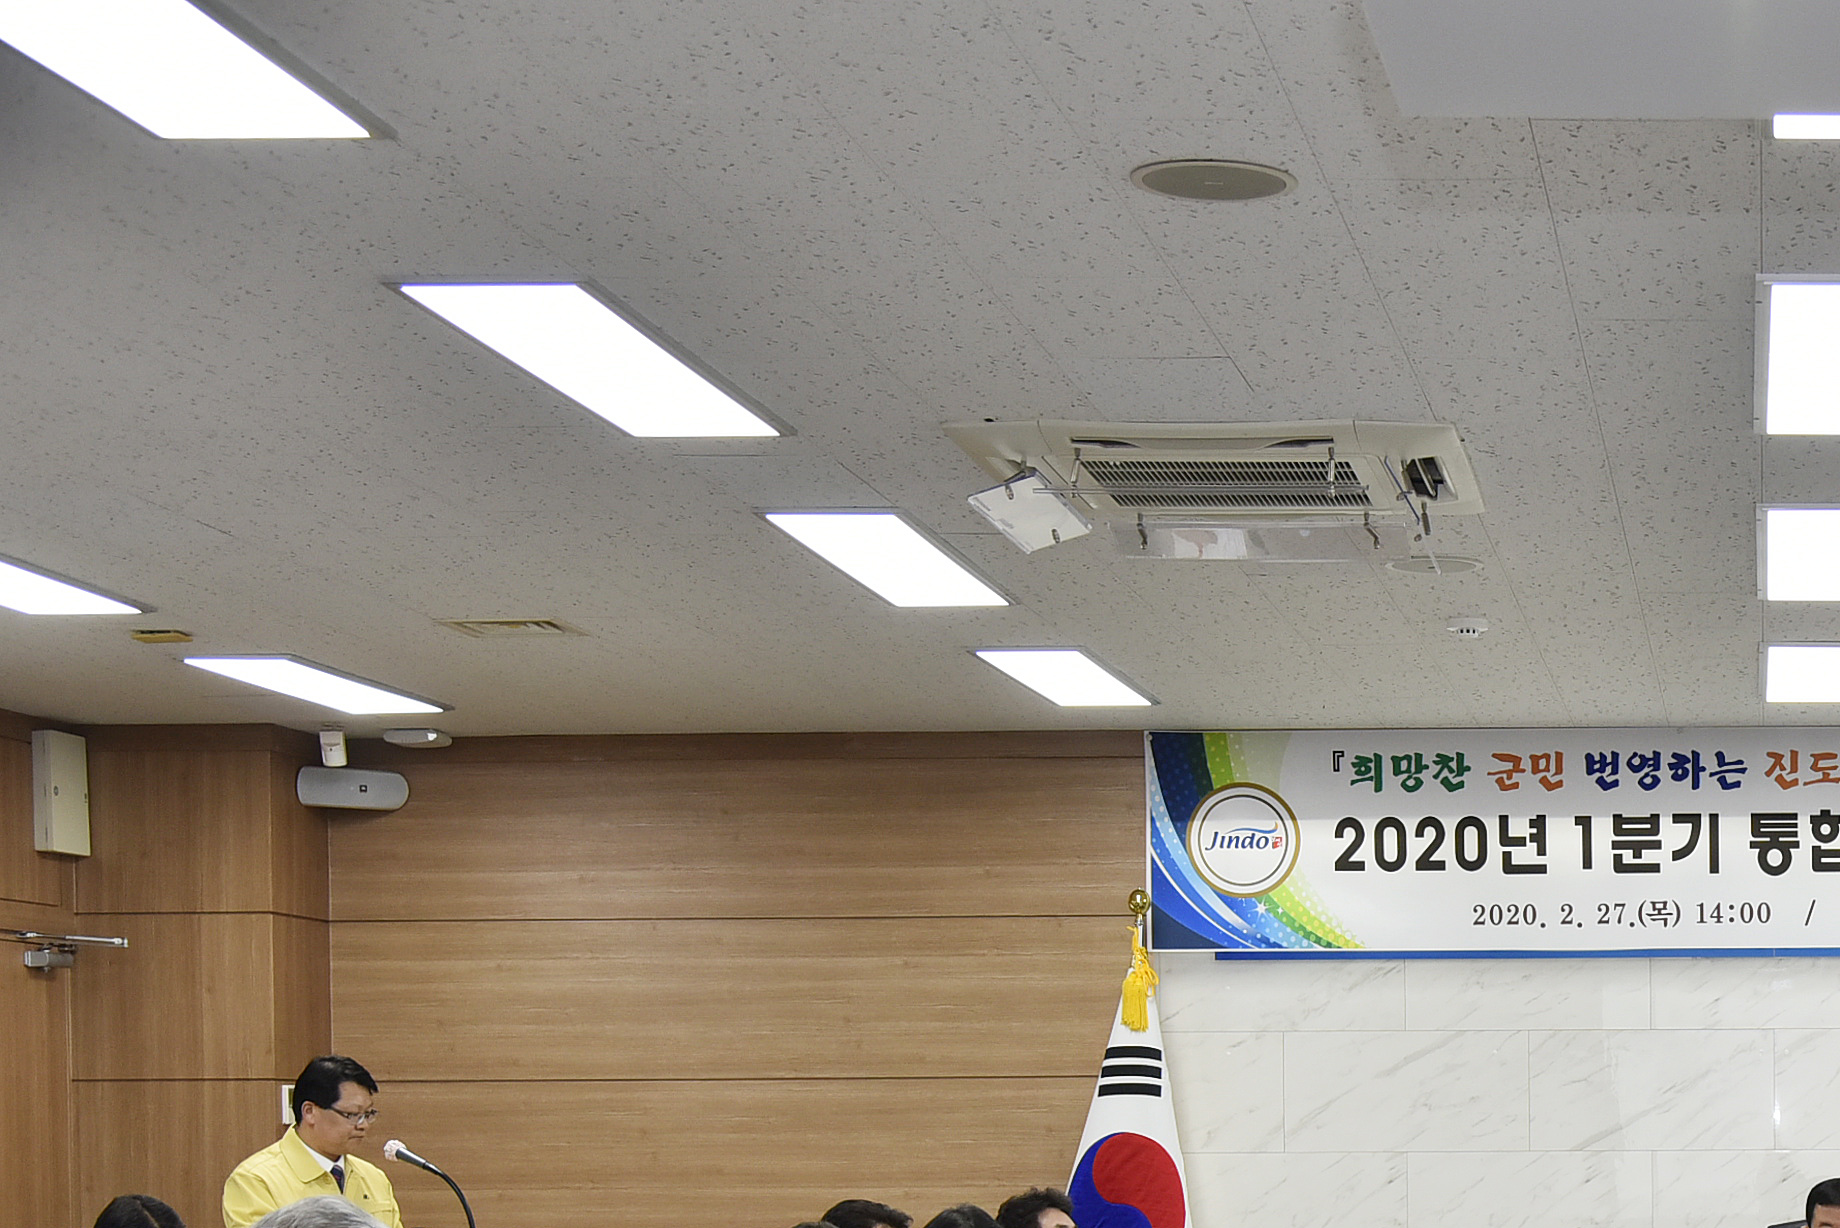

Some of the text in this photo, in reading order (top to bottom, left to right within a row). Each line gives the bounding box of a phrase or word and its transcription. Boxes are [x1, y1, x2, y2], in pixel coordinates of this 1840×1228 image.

[1487, 750, 1566, 791] 군민
[1585, 749, 1748, 791] 번영하는
[1205, 831, 1270, 851] Jindo
[1333, 812, 1549, 876] 2020년
[1574, 812, 1722, 875] 1분기
[1472, 902, 1547, 928] 2020.
[1560, 903, 1583, 928] 2.
[1696, 902, 1772, 924] 14:00
